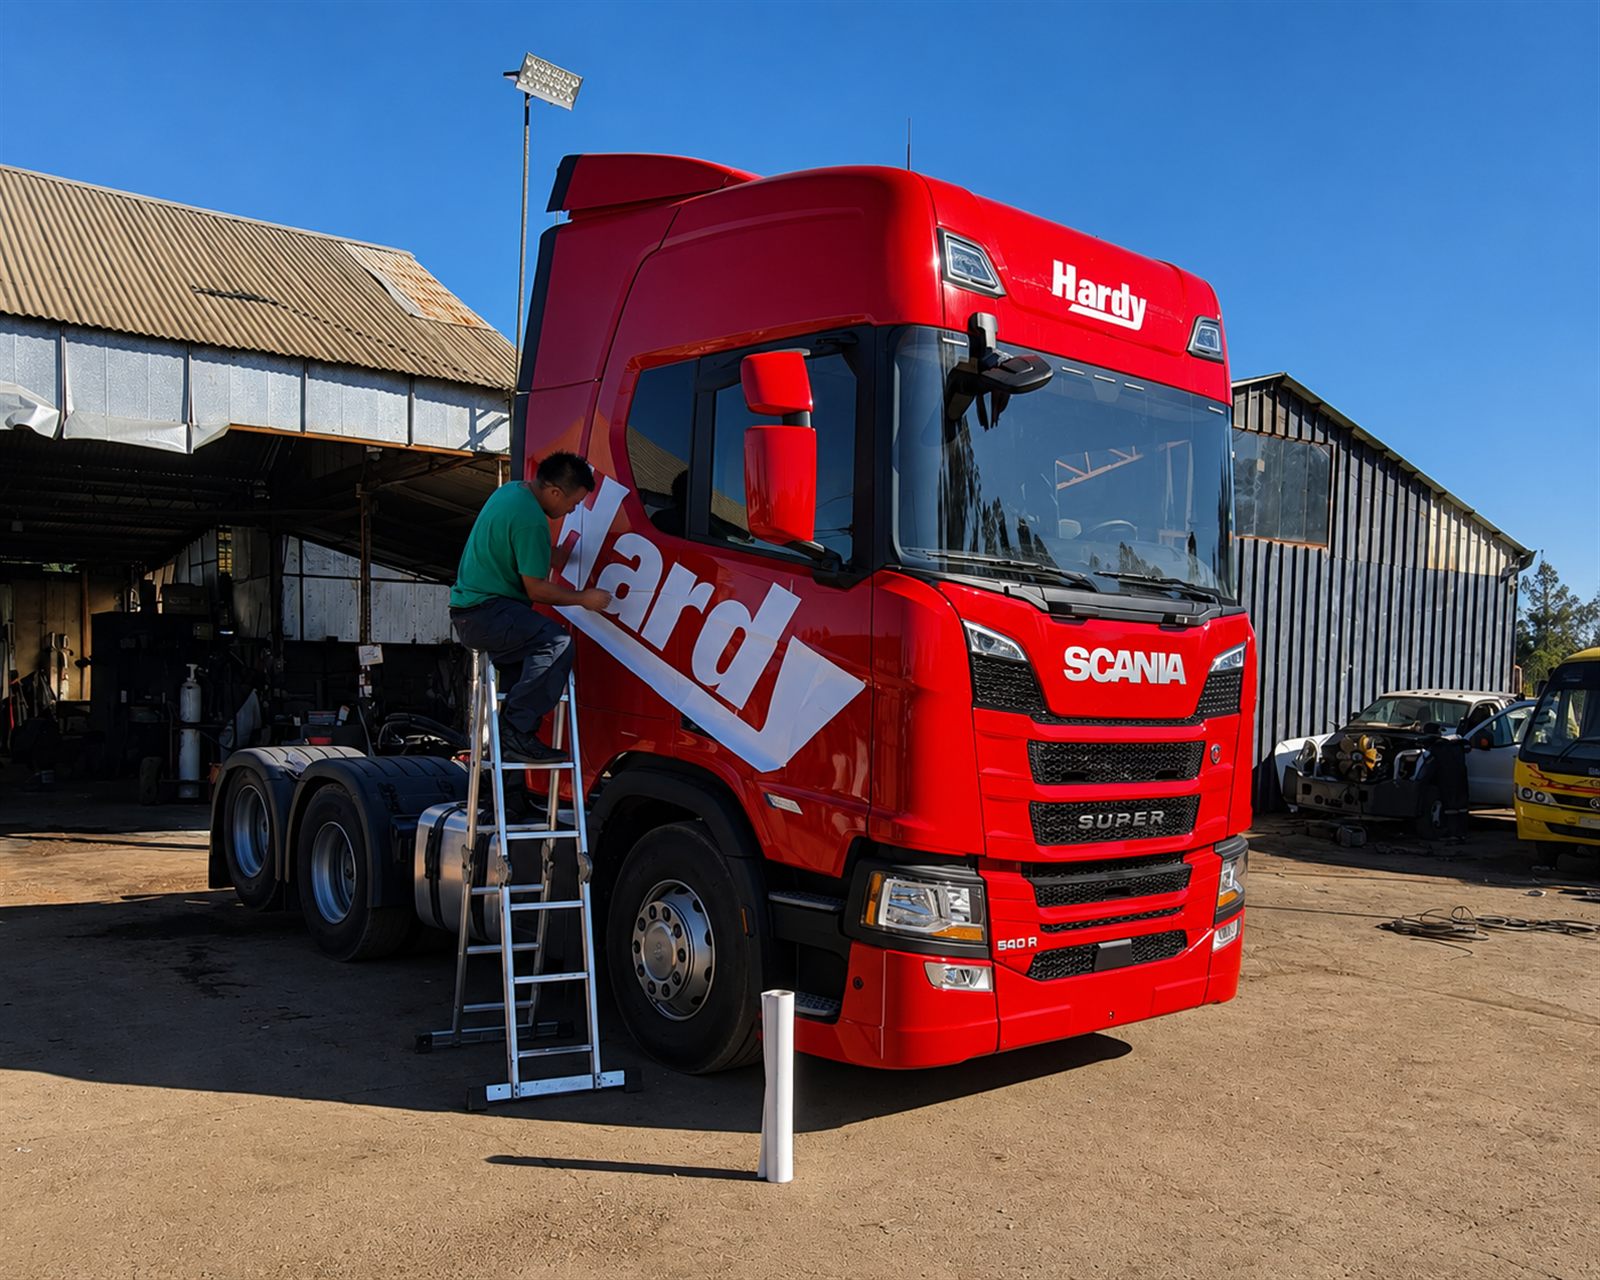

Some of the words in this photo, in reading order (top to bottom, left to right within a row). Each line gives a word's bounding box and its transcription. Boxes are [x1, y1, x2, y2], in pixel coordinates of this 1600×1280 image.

[1052, 259, 1147, 330] Hardy
[1063, 646, 1187, 685] SCANIA
[1078, 811, 1165, 829] SUPER
[997, 938, 1025, 951] 540
[1028, 936, 1037, 948] R
